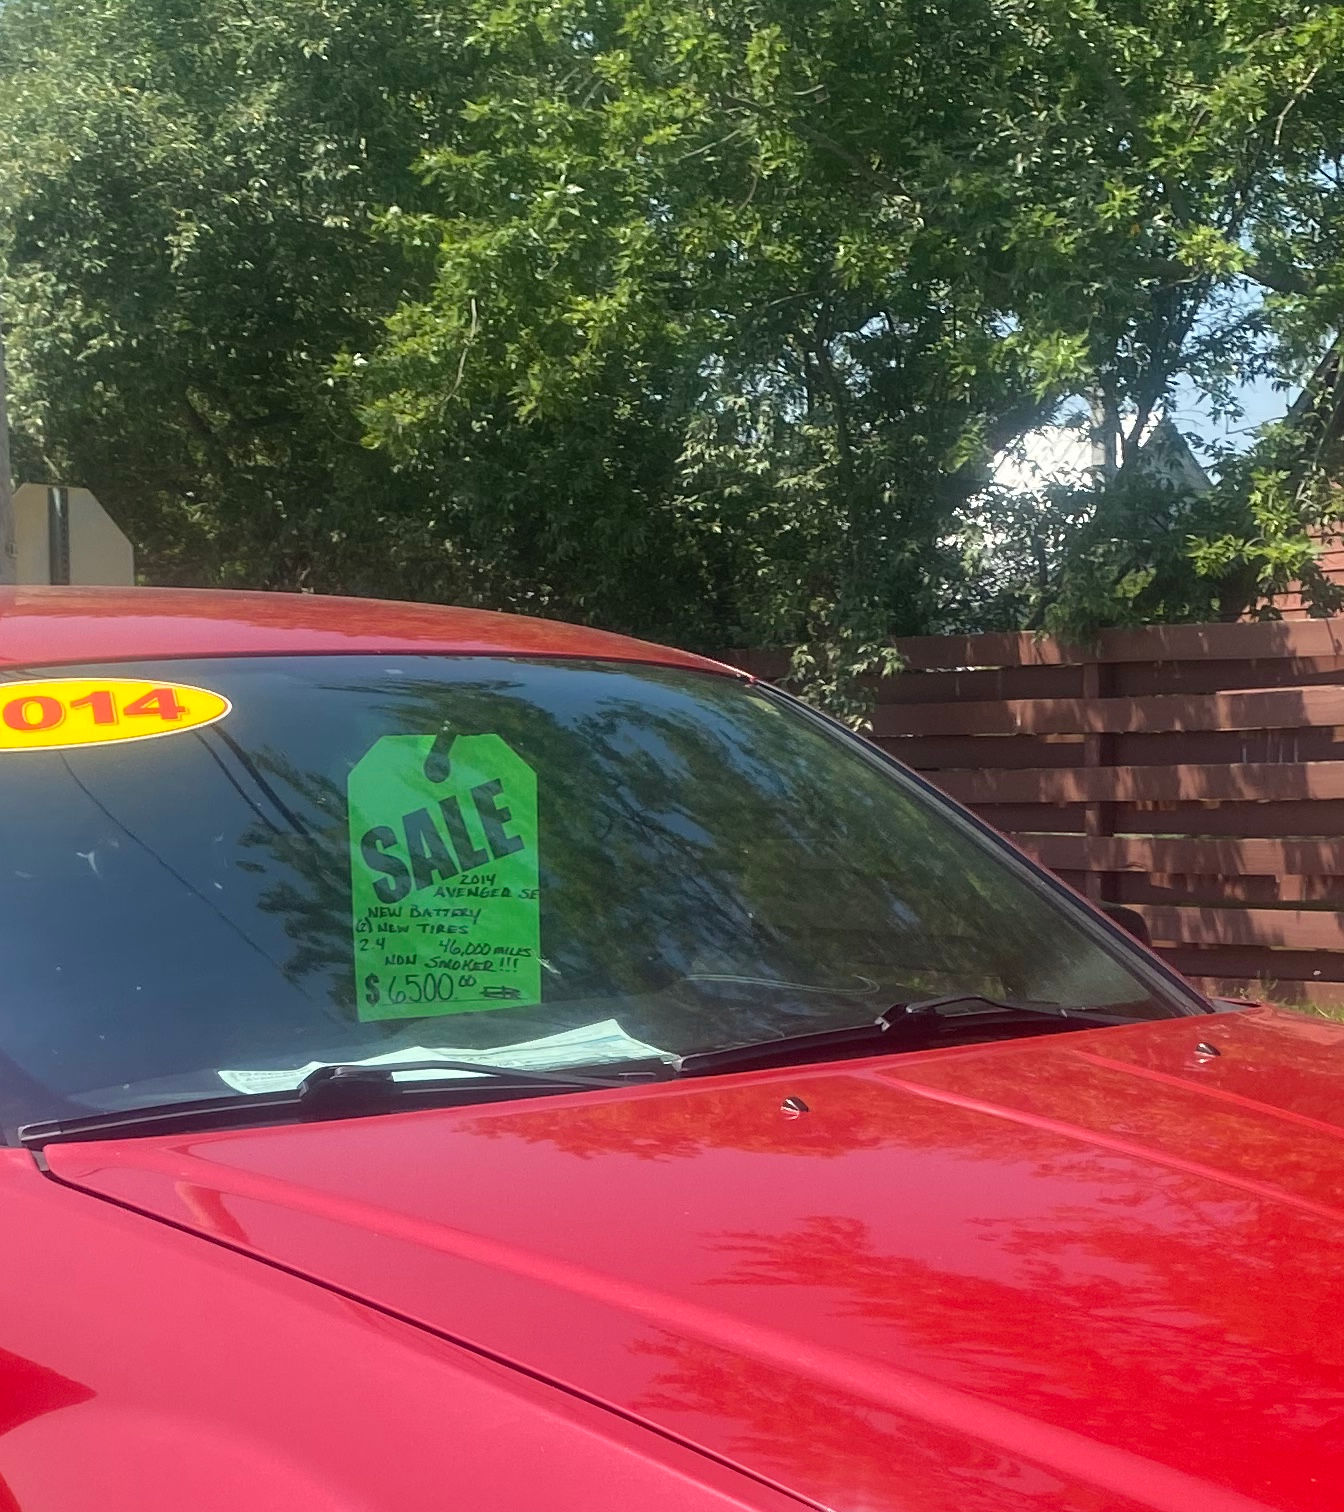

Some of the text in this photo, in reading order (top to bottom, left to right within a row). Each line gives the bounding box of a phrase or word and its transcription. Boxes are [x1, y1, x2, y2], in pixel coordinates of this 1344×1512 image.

[360, 778, 525, 905] SALE
[460, 873, 496, 886] 2014
[433, 886, 512, 898] AVENGER
[367, 905, 481, 925] NEW BATTERY
[377, 923, 410, 933] NEW
[416, 922, 469, 934] TIRES
[385, 954, 417, 966] NON
